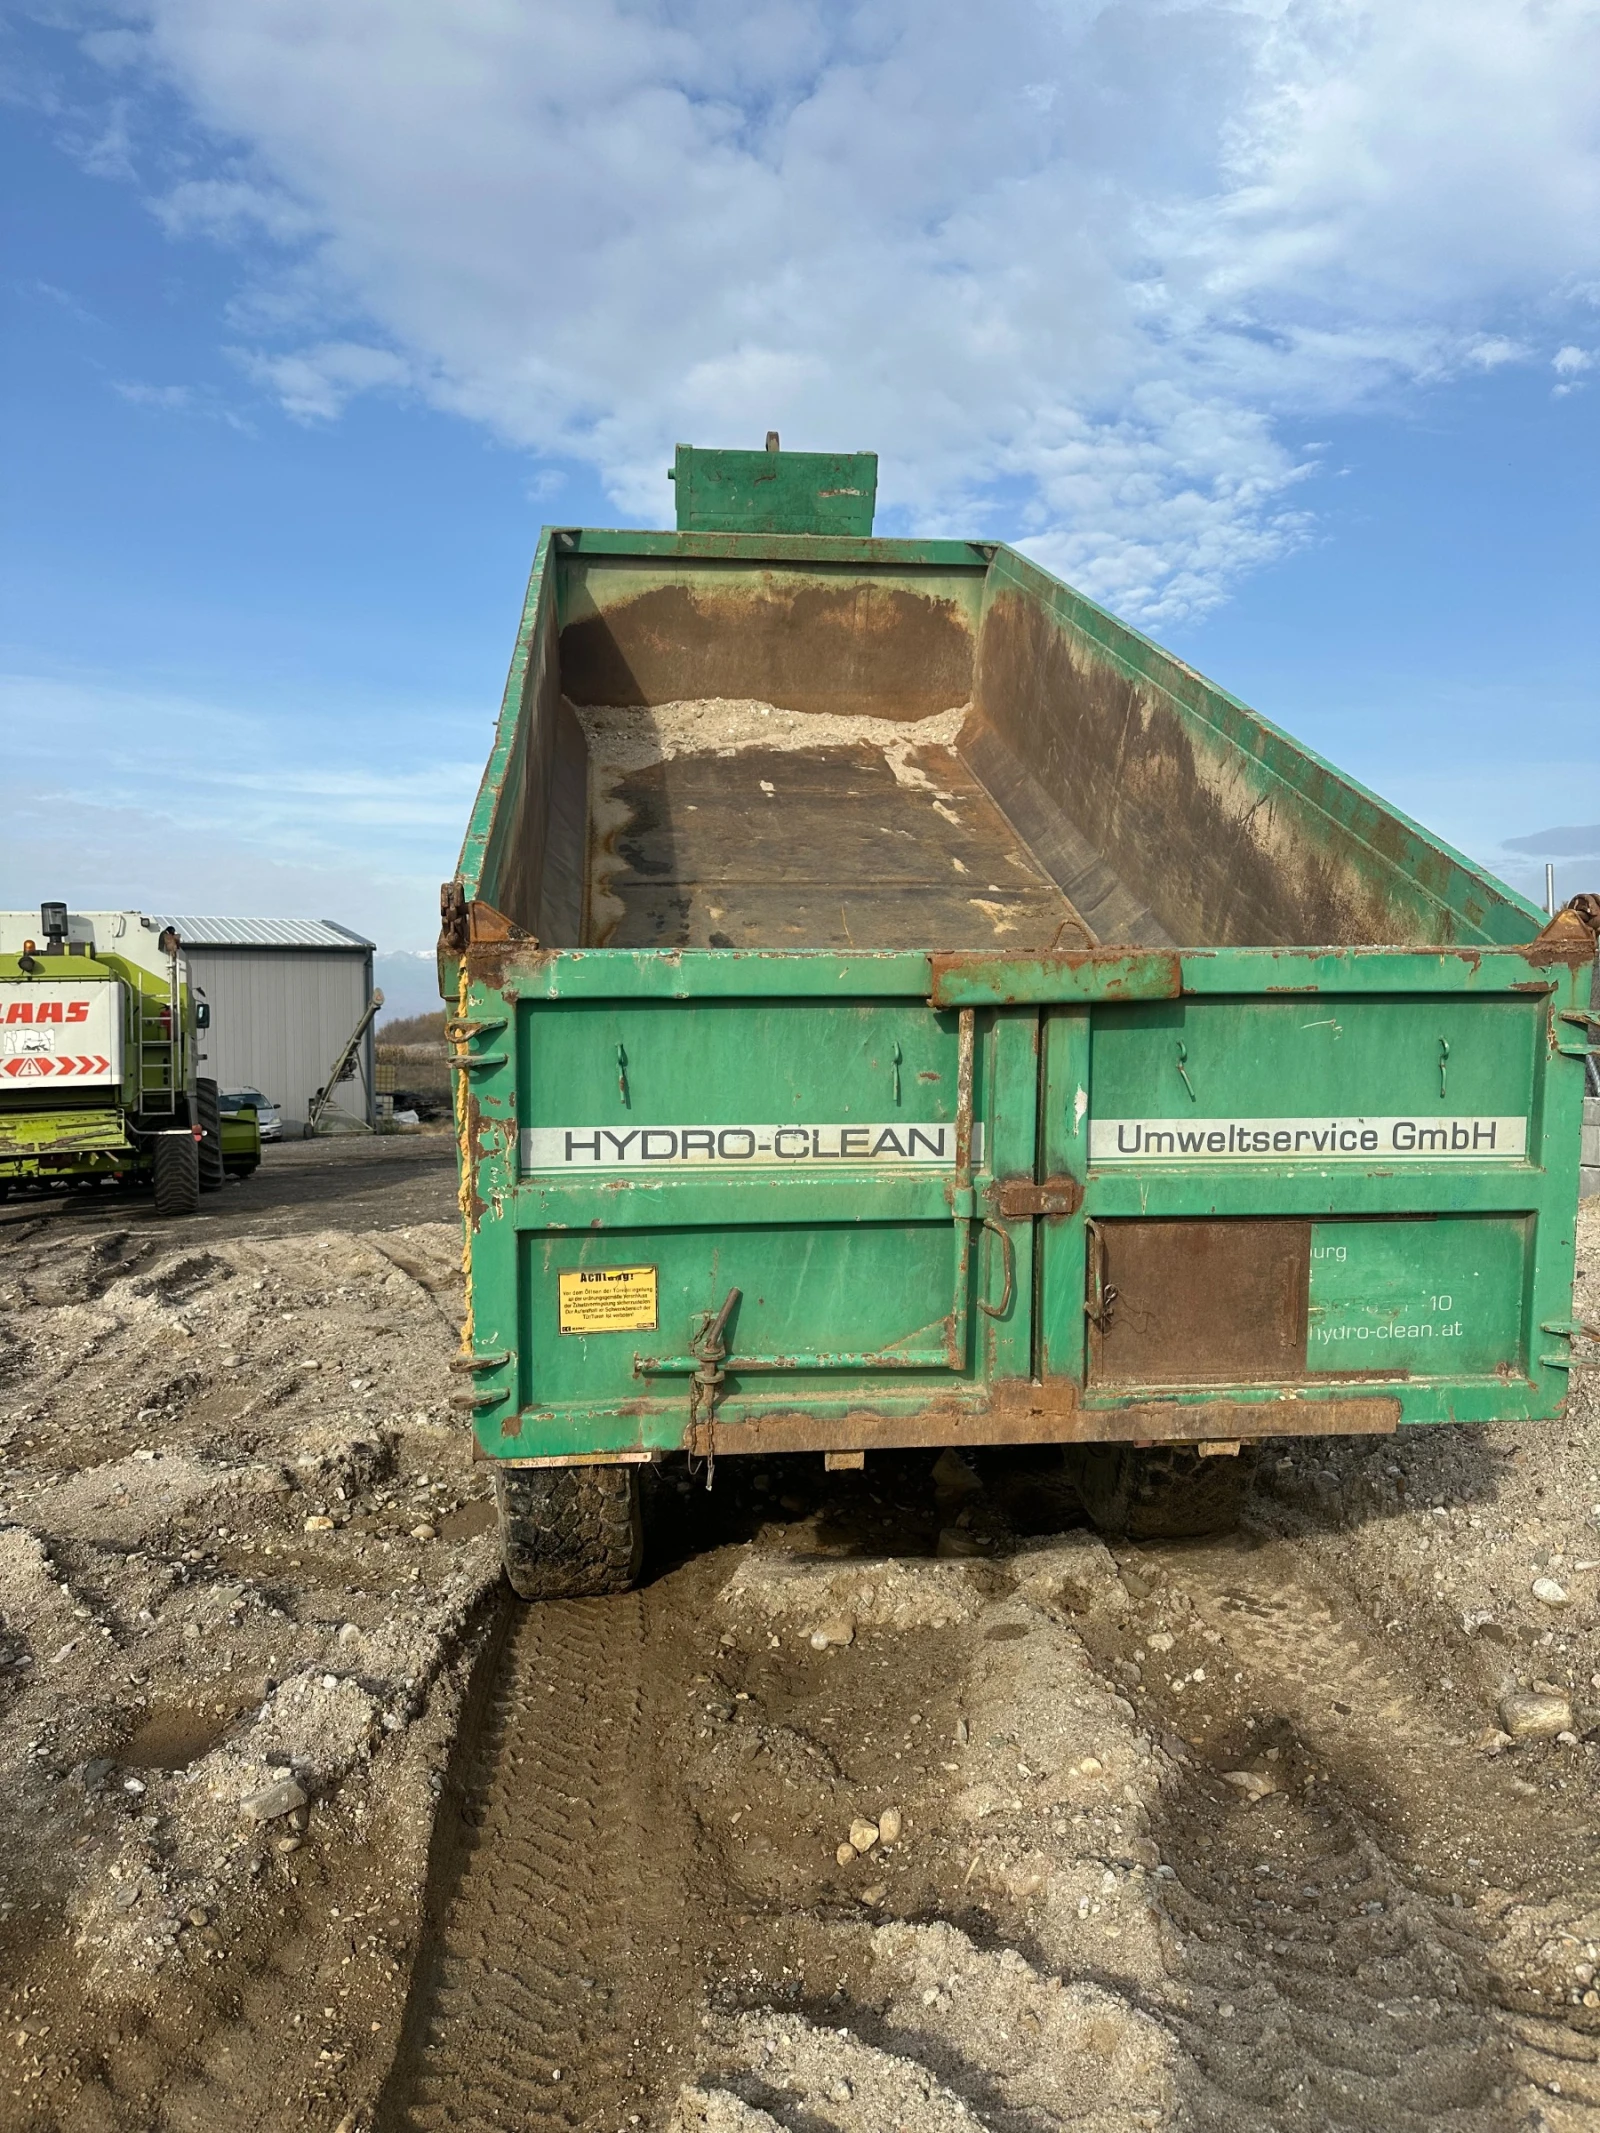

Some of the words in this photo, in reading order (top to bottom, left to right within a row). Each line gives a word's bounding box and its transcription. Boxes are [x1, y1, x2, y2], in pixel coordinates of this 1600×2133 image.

[0, 1002, 90, 1023] AAS
[565, 1127, 945, 1161] HYDRO-CLEAN
[1116, 1122, 1379, 1153] Umweltservice
[1391, 1120, 1497, 1151] GmbH
[1309, 1245, 1347, 1263] urg
[1429, 1294, 1453, 1311] 10
